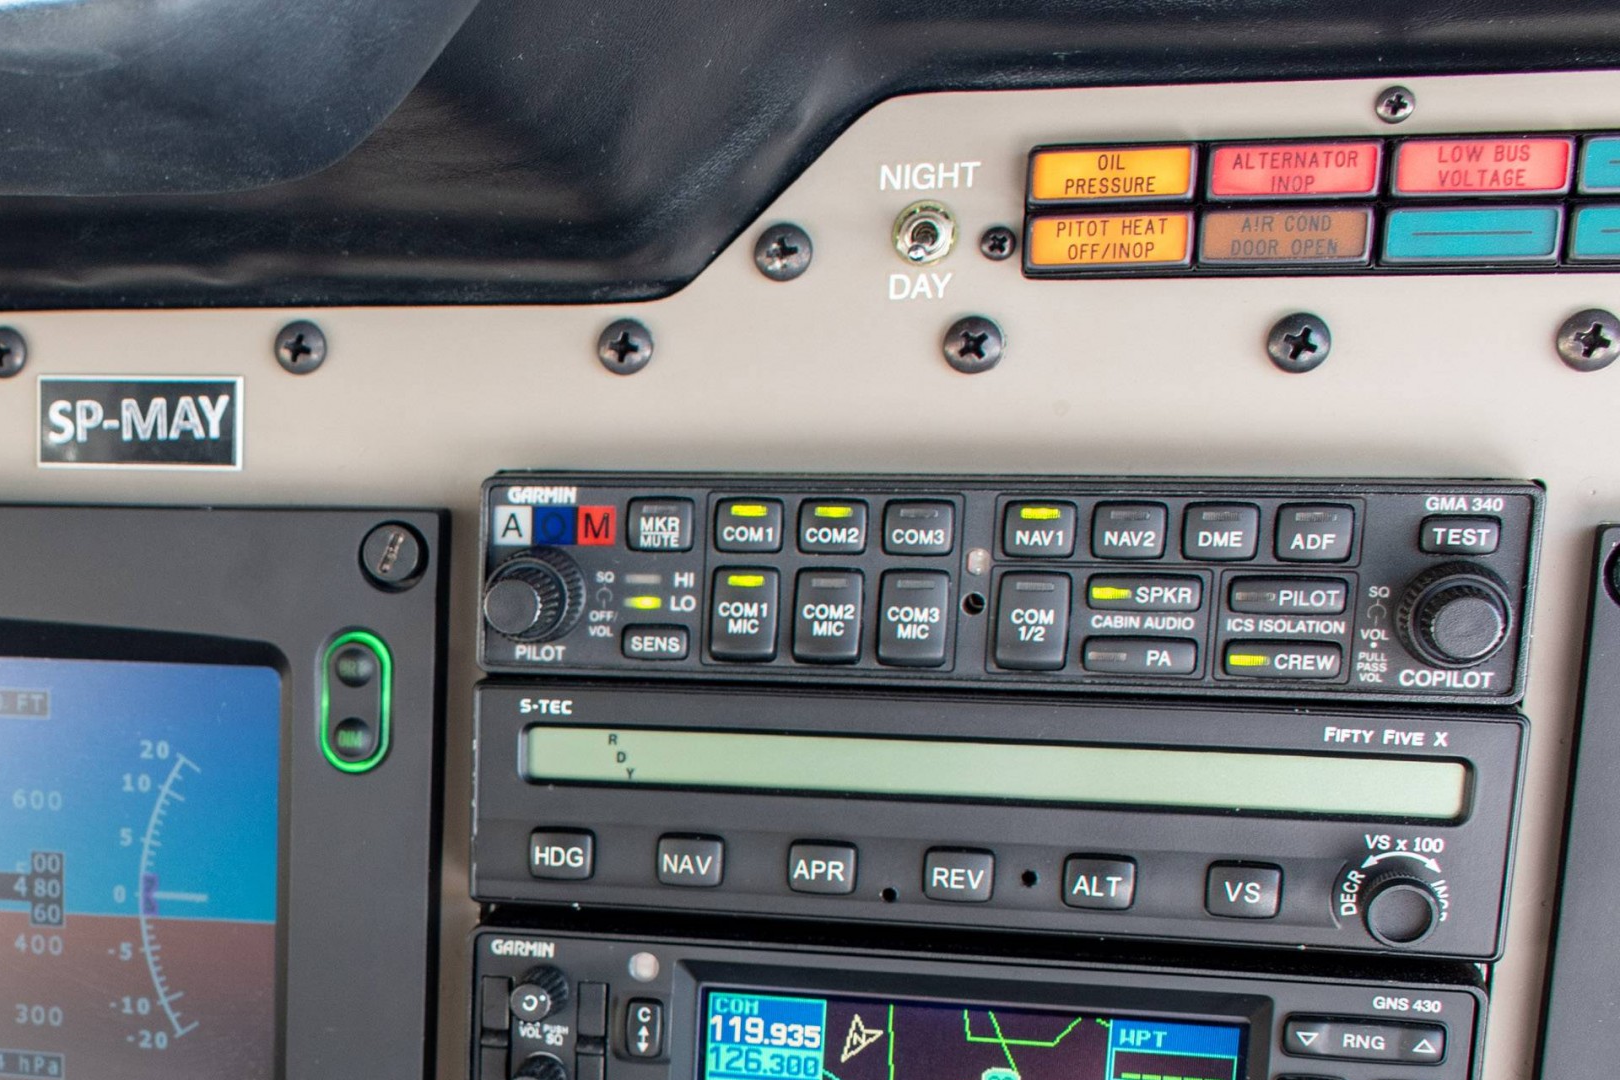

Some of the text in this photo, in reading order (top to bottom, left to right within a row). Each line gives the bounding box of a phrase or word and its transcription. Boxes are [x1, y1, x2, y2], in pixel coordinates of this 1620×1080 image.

[1097, 153, 1126, 171] OIL
[1233, 150, 1358, 171] ALTERNATOR
[1437, 144, 1530, 163] LOW BUS
[880, 161, 979, 190] NIGHT
[1270, 174, 1315, 193] INOP
[1437, 167, 1527, 188] VOLTAGE
[1065, 174, 1156, 196] PRESSURE
[1056, 217, 1168, 238] PITOT HEAT
[1241, 213, 1332, 235] AIR COND
[1067, 239, 1155, 261] OFF/INOP
[1231, 236, 1338, 257] DOOR OPEN
[888, 274, 952, 300] DAY
[47, 394, 229, 445] SP-MAY
[507, 486, 577, 503] GARMIN
[1426, 496, 1503, 512] GMA 340
[640, 517, 680, 533] MKR
[639, 533, 680, 548] MUTE
[722, 526, 774, 543] COM1
[805, 527, 859, 544] COM2
[892, 529, 944, 545] COM3
[1015, 530, 1064, 546] NAV1
[1104, 531, 1155, 547] NAV2
[1197, 531, 1243, 547] DME
[1290, 533, 1335, 551] ADF
[1433, 528, 1490, 547] TEST
[674, 572, 695, 587] HI
[670, 595, 696, 612] LO
[1135, 586, 1192, 605] SPKR
[1279, 590, 1340, 607] PILOT
[718, 602, 768, 618] COM1
[802, 604, 855, 620] COM2
[887, 607, 940, 624] COM3
[1010, 609, 1054, 626] COM
[728, 618, 759, 635] MIC
[812, 620, 845, 637] MIC
[897, 623, 929, 640] MIC
[1091, 615, 1194, 631] CABIN AUDIO
[1226, 620, 1345, 635] ICS ISOLATION
[631, 636, 680, 653] SENS
[515, 646, 566, 662] PILOT
[1146, 650, 1172, 667] PA
[1274, 654, 1335, 670] CREW
[1399, 669, 1494, 689] COPILOT
[17, 694, 43, 714] FT
[1324, 726, 1448, 747] FIFTY FIVE X
[140, 740, 169, 760] 20
[122, 774, 151, 792] 10
[13, 790, 63, 811] 600
[120, 828, 133, 846] 5
[534, 845, 584, 866] HDG
[663, 854, 712, 875] NAV
[793, 860, 844, 882] APR
[932, 867, 984, 890] REV
[113, 885, 126, 903] 0
[1073, 876, 1122, 897] ALT
[1224, 881, 1260, 903] VS
[14, 935, 63, 956] 400
[491, 938, 555, 958] GARMIN
[716, 998, 759, 1014] COM
[1373, 996, 1442, 1013] GNS 430
[15, 1005, 63, 1026] 300
[710, 1015, 821, 1048] 119.935
[1119, 1029, 1167, 1048] WPT
[1343, 1033, 1386, 1051] RNG
